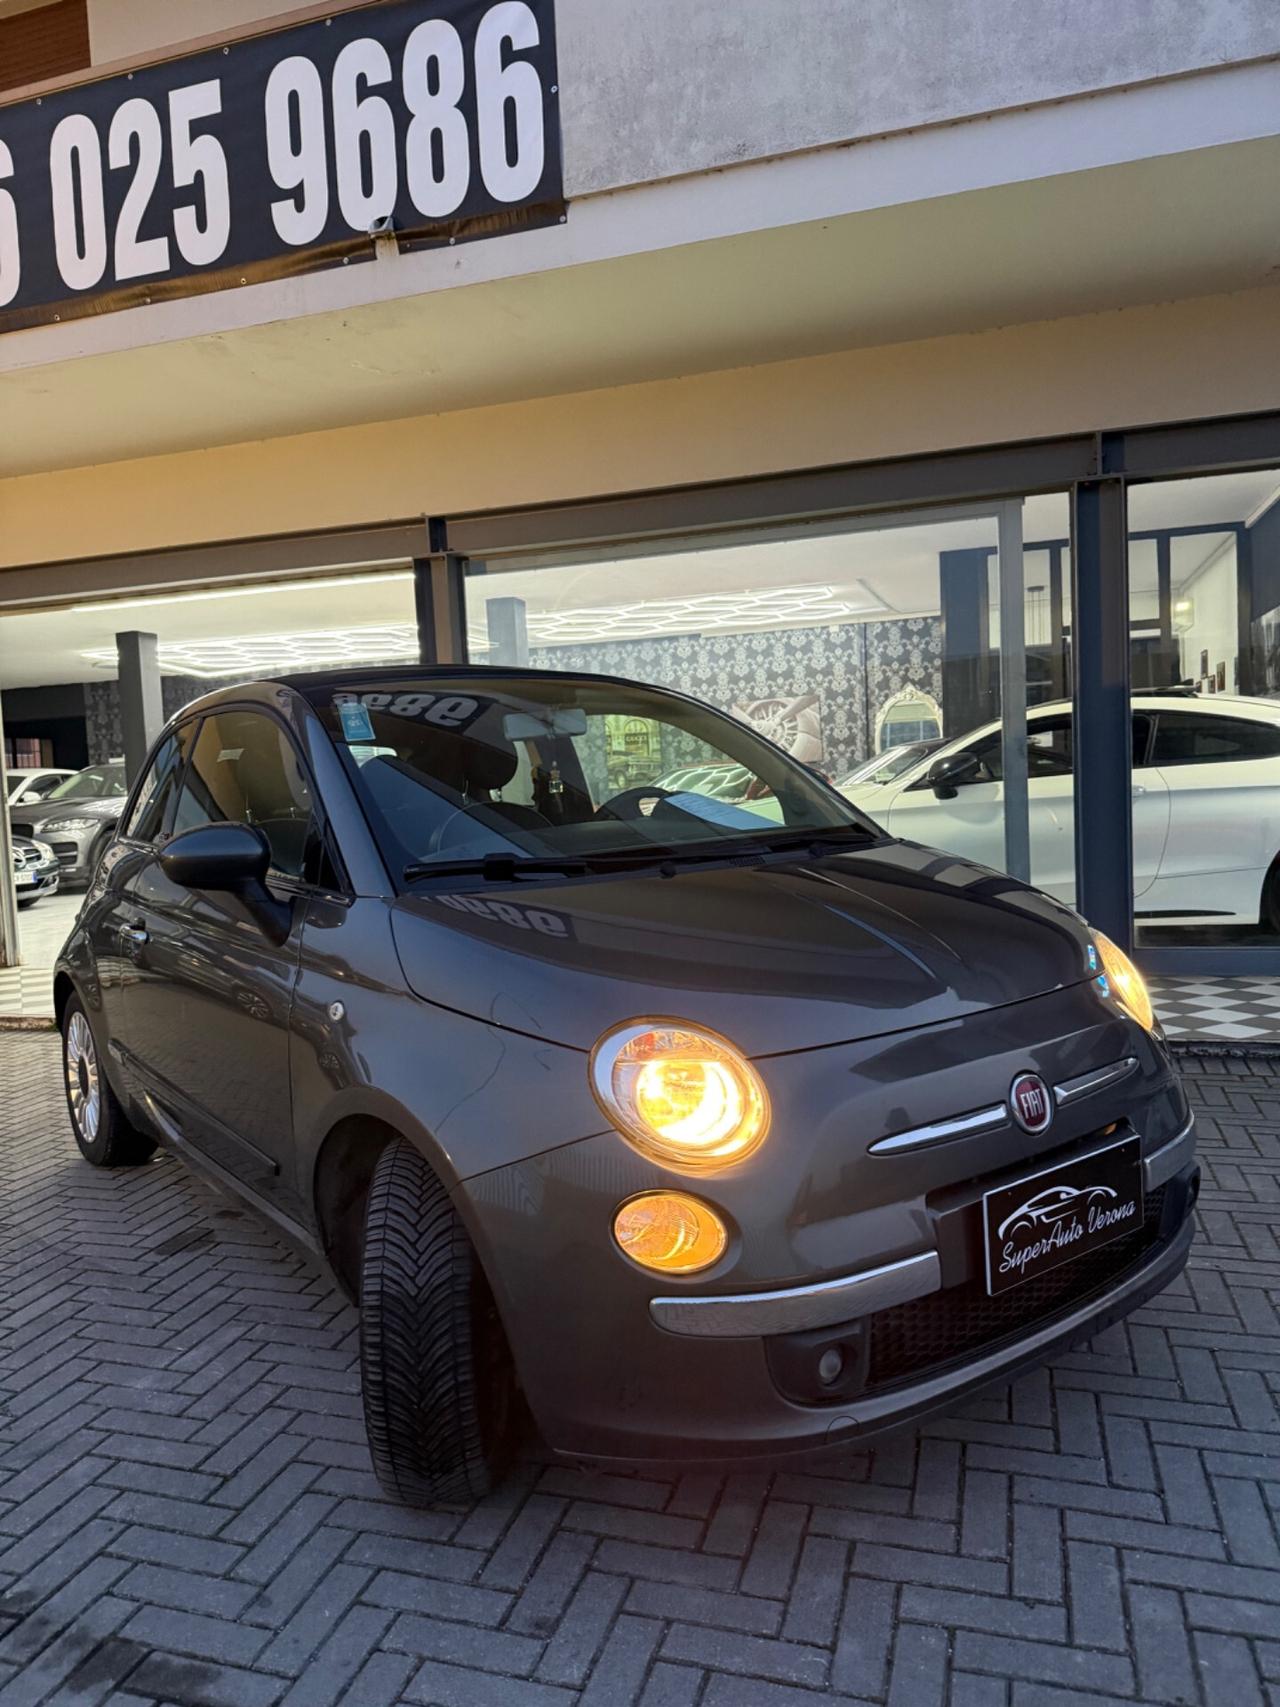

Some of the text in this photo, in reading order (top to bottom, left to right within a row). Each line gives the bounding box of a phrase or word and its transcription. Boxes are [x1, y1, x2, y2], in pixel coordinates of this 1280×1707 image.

[50, 79, 231, 291] 025
[265, 1, 545, 246] 9686
[1020, 1087, 1044, 1119] FIAT
[999, 1201, 1136, 1274] SuperAuto Verona
